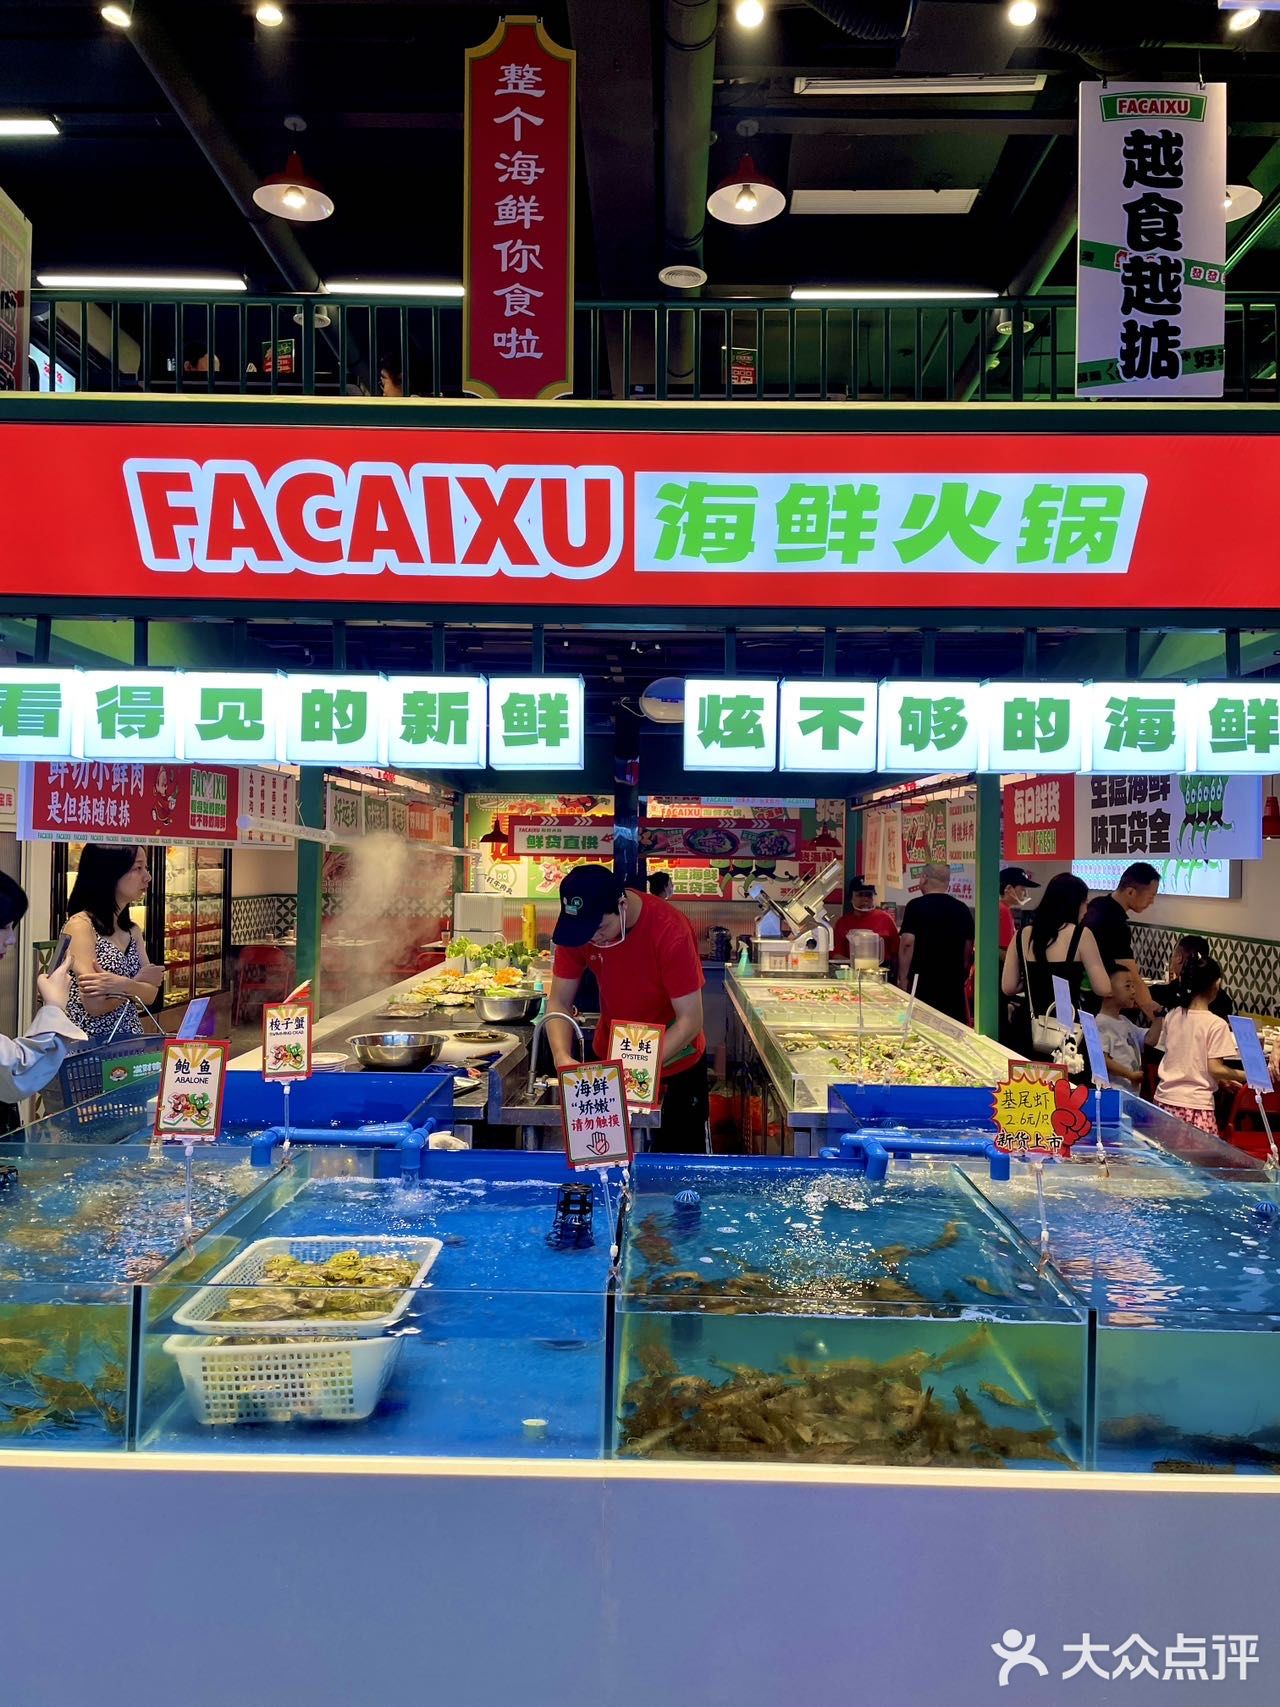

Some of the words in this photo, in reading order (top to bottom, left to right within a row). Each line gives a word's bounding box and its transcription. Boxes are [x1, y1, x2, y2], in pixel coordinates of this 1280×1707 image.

[1117, 95, 1191, 115] FACAIXU
[493, 63, 545, 360] 整个海鲜你食啦
[1120, 129, 1184, 380] 越食越掂
[132, 468, 615, 571] FACAIXU
[653, 481, 1126, 565] 海鲜火锅
[0, 683, 570, 747] 看得见的新鲜
[698, 694, 1279, 754] 炫不够的海鲜
[1091, 775, 1171, 809] 生猛海鲜
[1013, 781, 1060, 825] 每日鲜货
[1091, 808, 1171, 855] 味正货全
[526, 834, 598, 850] 鲜货直供
[269, 1017, 305, 1031] 梭子蟹
[620, 1038, 652, 1054] 生蚝
[174, 1058, 212, 1076] 鲍鱼
[621, 1053, 649, 1061] OYSTERS
[175, 1076, 209, 1085] ABALONE
[574, 1076, 609, 1097] 海鲜
[1001, 1090, 1050, 1109] 基尾虾
[570, 1114, 621, 1132] 请勿触摸
[997, 1131, 1063, 1151] 新货上市
